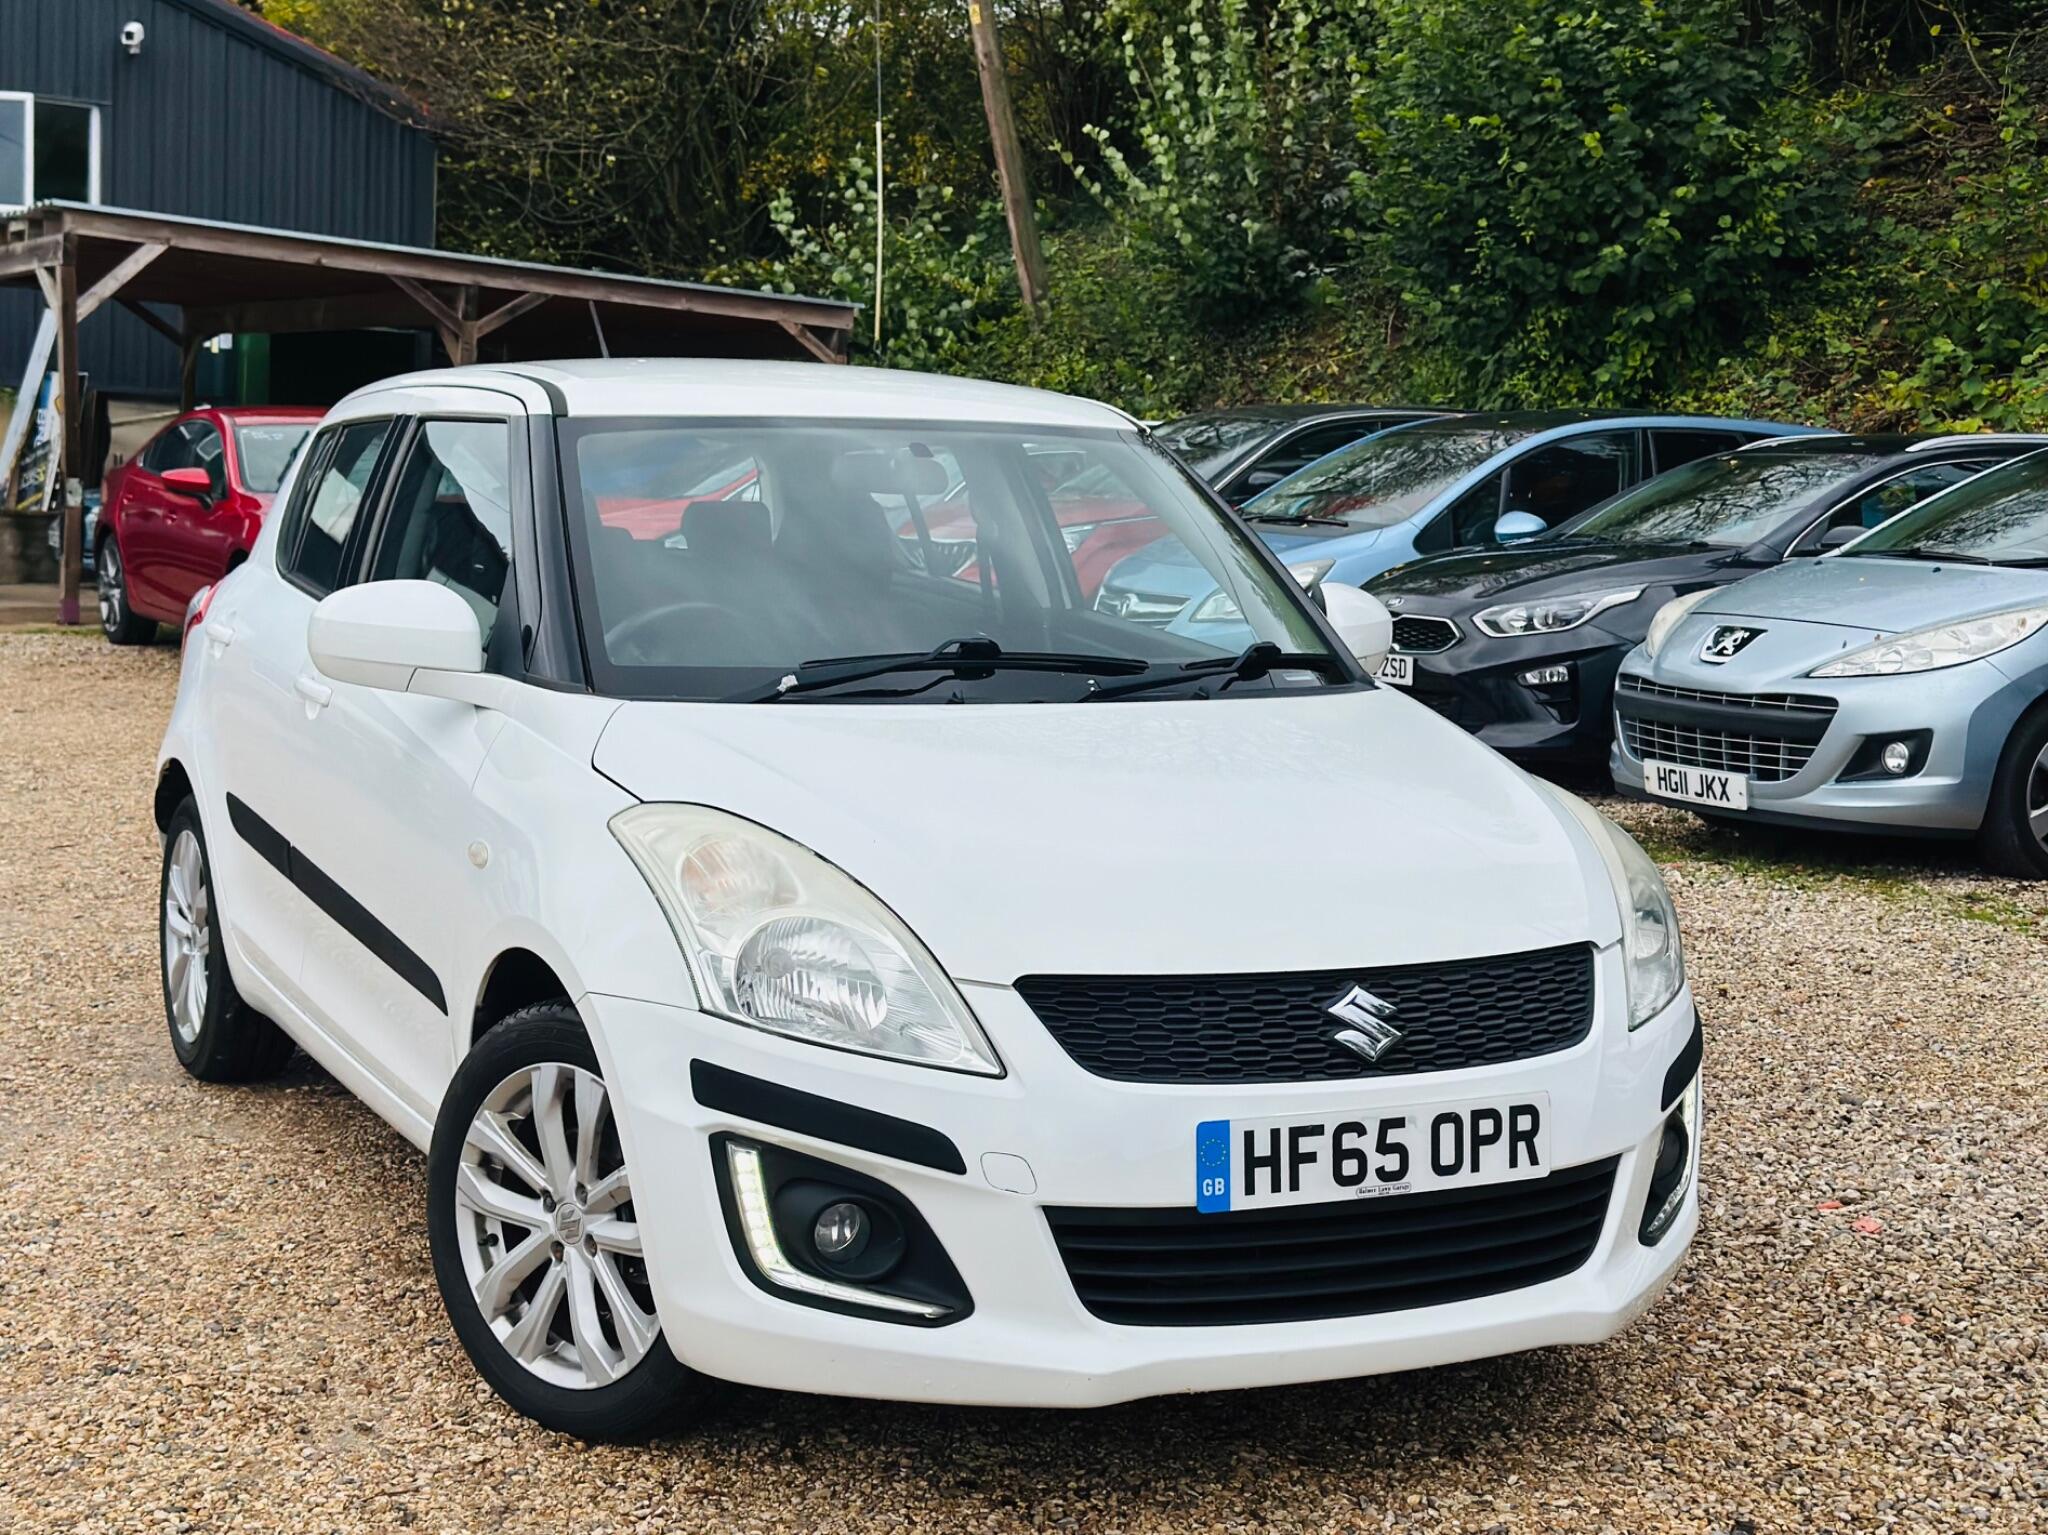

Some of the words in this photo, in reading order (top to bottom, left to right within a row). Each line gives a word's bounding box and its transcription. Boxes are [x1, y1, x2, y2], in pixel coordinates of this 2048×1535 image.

[1657, 766, 1689, 796] HG11
[1694, 774, 1731, 803] JKX
[1243, 1116, 1409, 1196] HF65
[1430, 1103, 1540, 1177] OPR
[1202, 1177, 1225, 1197] GB
